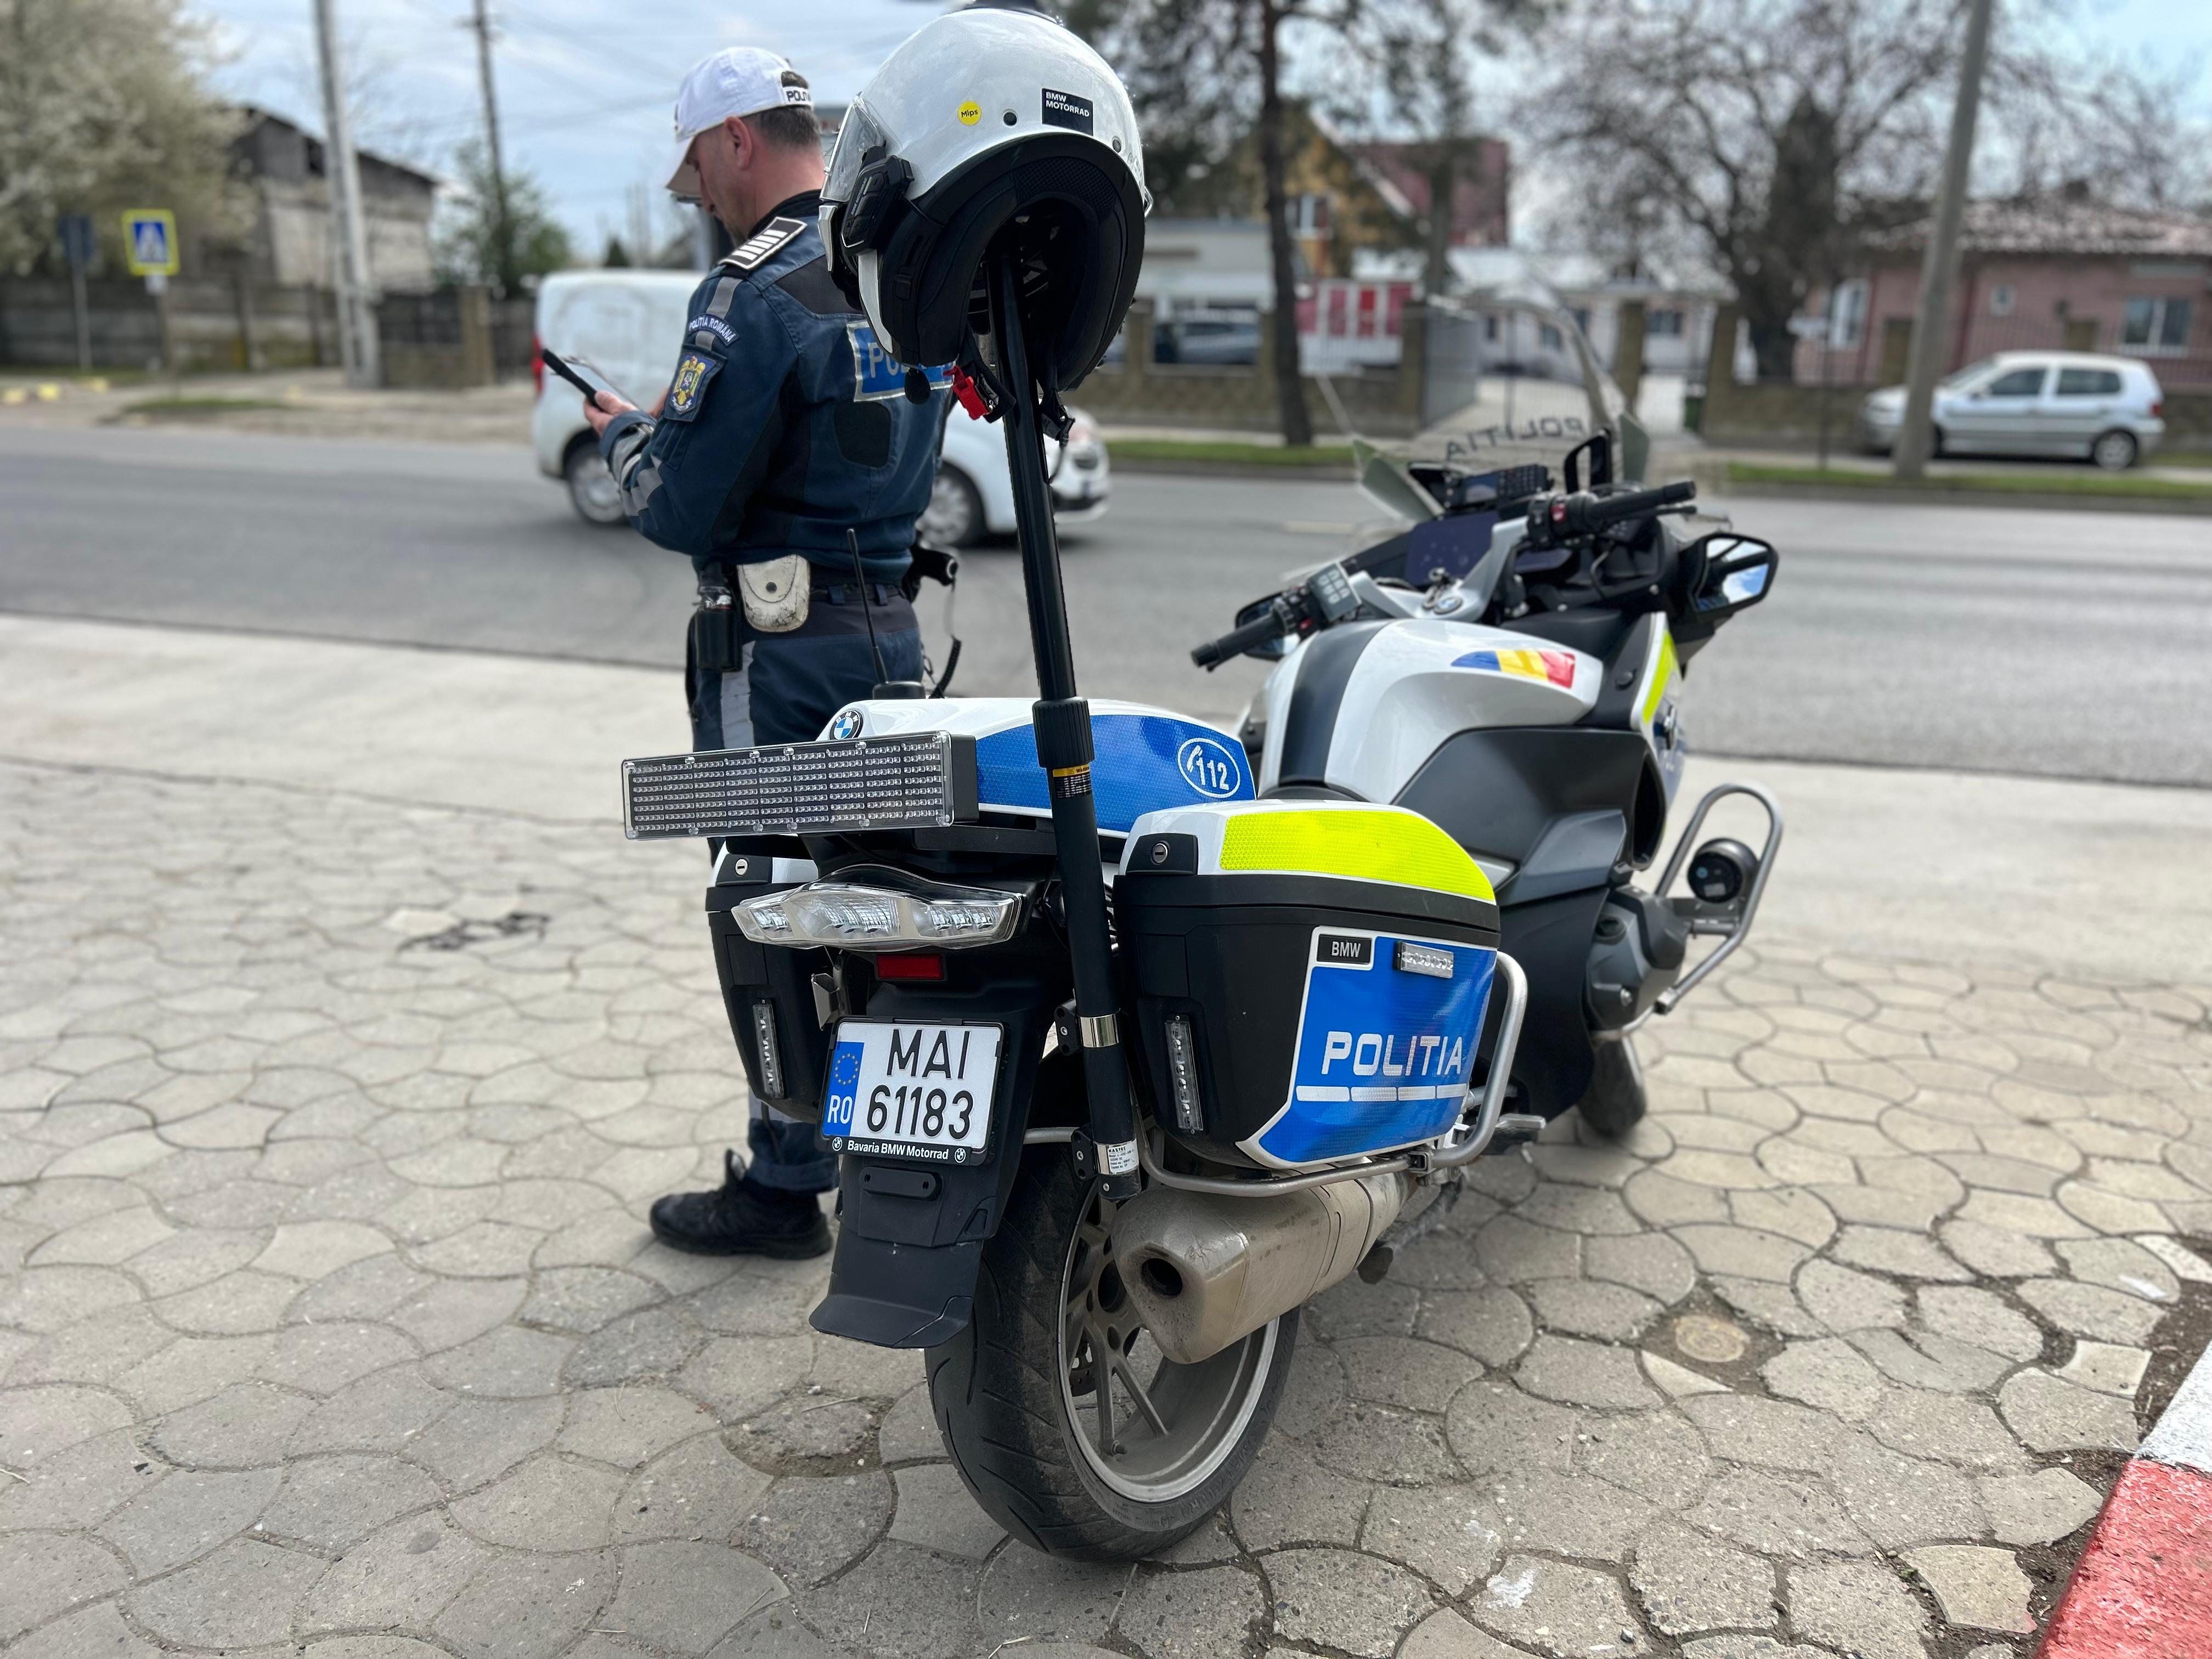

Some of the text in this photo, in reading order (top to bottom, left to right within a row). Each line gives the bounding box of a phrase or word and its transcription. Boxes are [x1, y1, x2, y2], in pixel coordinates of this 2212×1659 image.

[1046, 92, 1066, 103] BMW
[1046, 100, 1090, 117] MOTORRAD
[1196, 757, 1229, 790] 112
[1331, 941, 1361, 957] BMW
[887, 1029, 970, 1079] MAI
[1321, 1031, 1462, 1076] POLITIA
[827, 1095, 853, 1124] RO
[867, 1085, 973, 1140] 61183
[847, 1140, 949, 1160] Bavaria BMW Motorrad
